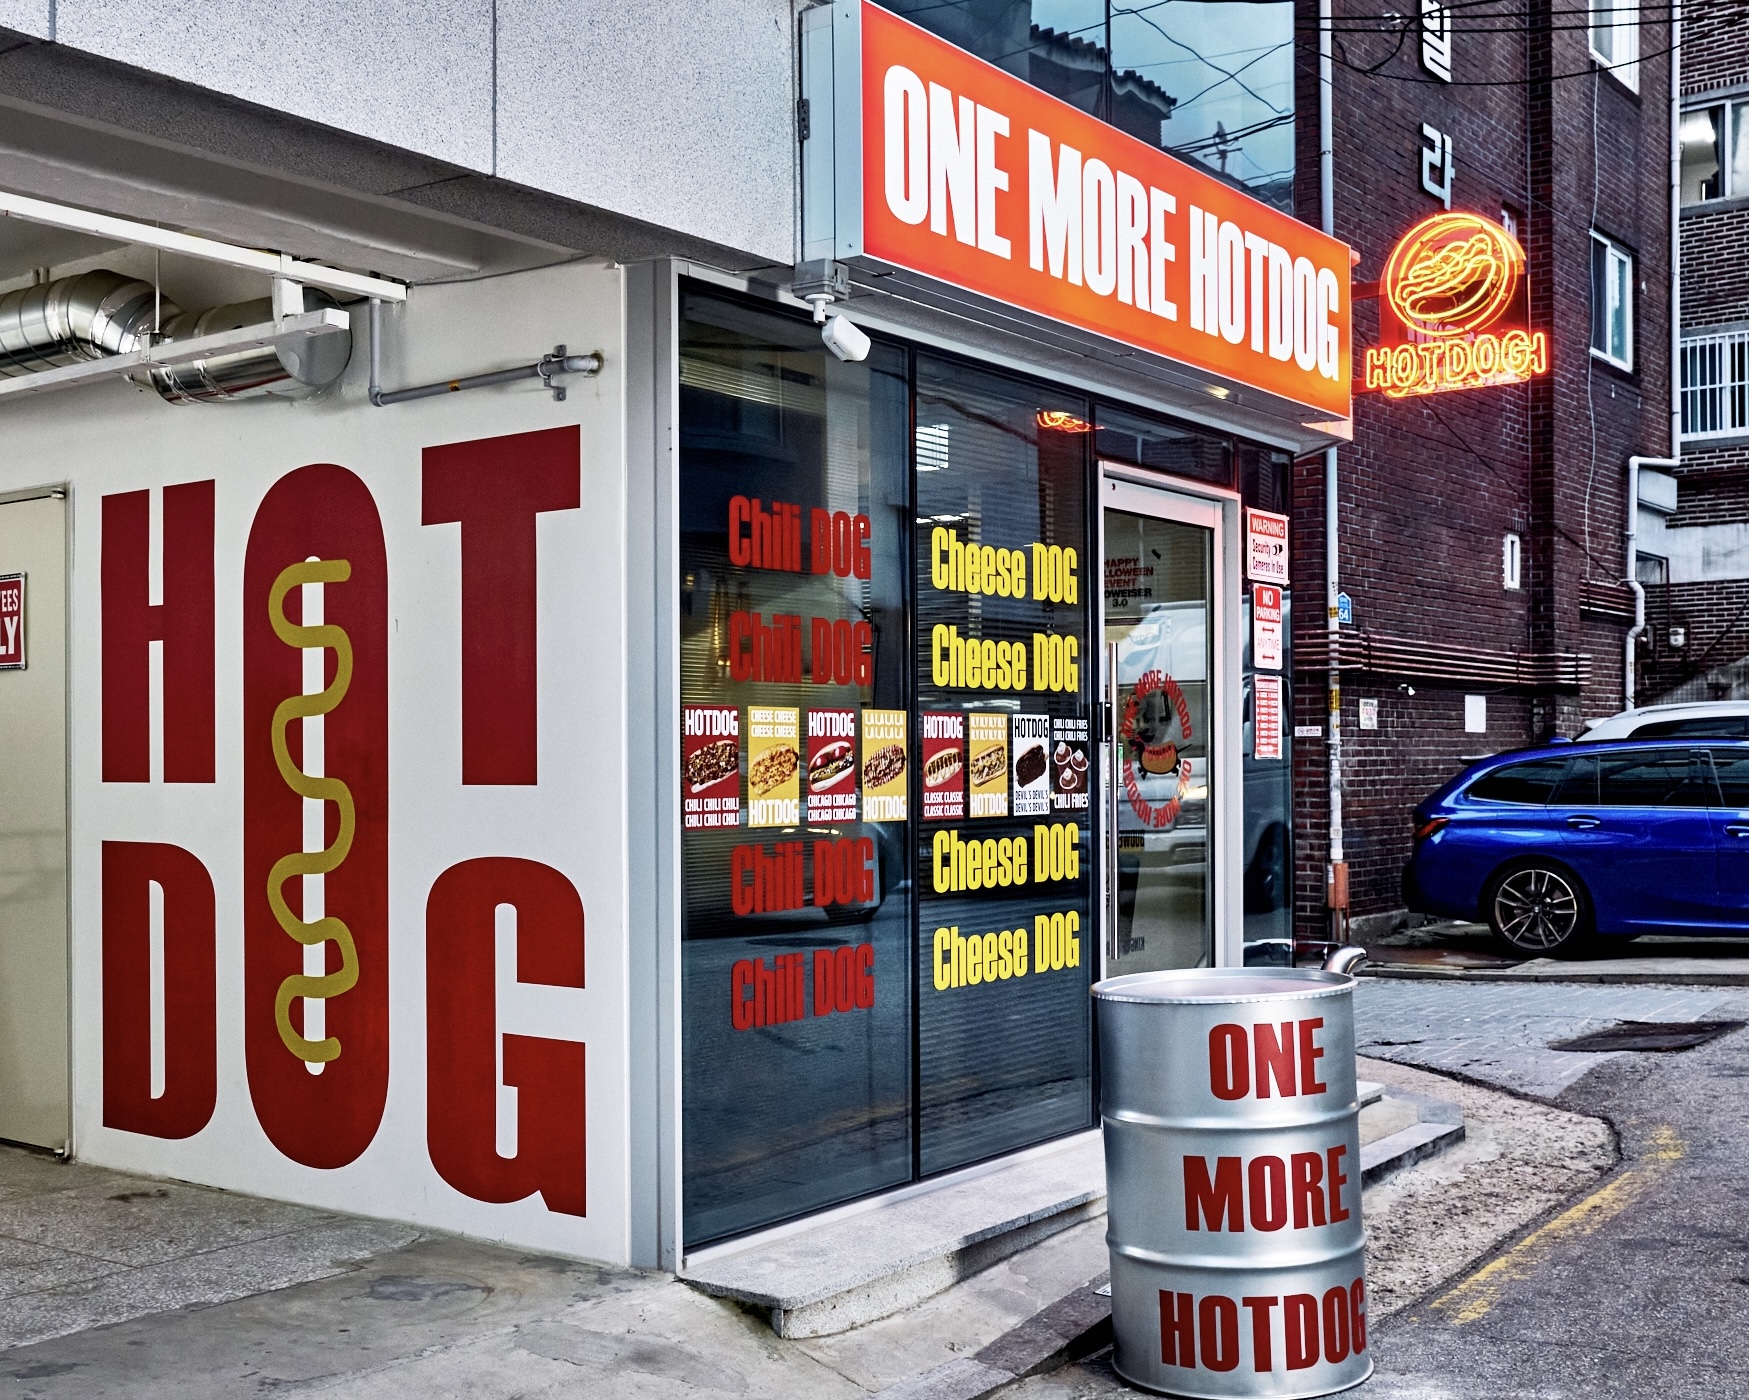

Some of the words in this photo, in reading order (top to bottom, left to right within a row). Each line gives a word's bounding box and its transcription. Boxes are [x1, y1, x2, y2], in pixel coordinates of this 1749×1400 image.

[884, 65, 1011, 260] ONE
[1028, 128, 1177, 322] MORE
[1190, 204, 1339, 382] HOTDOG
[1366, 330, 1532, 389] HOTDOG
[729, 495, 800, 571] Chili
[810, 508, 871, 580] DOG
[1252, 517, 1283, 537] WARNING
[1253, 539, 1270, 557] Security
[931, 527, 1026, 598] Cheese
[1033, 542, 1078, 604] DOG
[0, 589, 18, 612] EES
[1112, 599, 1128, 607] 3.0
[1262, 590, 1273, 606] NO
[101, 424, 581, 815] HOT
[1257, 606, 1280, 621] PARKING
[729, 610, 800, 684] Chili
[811, 617, 872, 686] DOG
[931, 624, 1026, 690] Cheese
[1033, 633, 1078, 693] DOG
[685, 709, 738, 736] HOTDOG
[751, 710, 773, 722] CHEESE
[775, 711, 796, 723] CHEESE
[808, 712, 854, 737] HOTDOG
[924, 716, 963, 739] HOTDOG
[1014, 718, 1048, 738] HOTDOG
[751, 725, 773, 737] CHEESE
[775, 726, 796, 738] CHEESE
[685, 799, 702, 812] CHILI
[704, 798, 721, 811] CHILI
[723, 797, 739, 810] CHILI
[808, 795, 832, 807] CHICAGO
[833, 794, 856, 806] CHICAGO
[863, 795, 907, 819] HOTDOG
[924, 792, 943, 803] CLASSIC
[944, 791, 963, 802] CLASSIC
[970, 793, 1008, 815] HOTDOG
[1054, 793, 1070, 808] CHILI
[1072, 793, 1088, 808] FRIES
[685, 814, 702, 827] CHILI
[704, 813, 721, 827] CHILI
[723, 812, 739, 826] CHILI
[750, 799, 799, 825] HOTDOG
[808, 809, 832, 821] CHICAGO
[833, 808, 856, 820] CHICAGO
[924, 805, 943, 816] CLASSIC
[944, 805, 963, 816] CLASSIC
[933, 830, 1027, 894] Cheese
[1034, 822, 1079, 883] DOG
[732, 842, 803, 916] Chili
[813, 837, 874, 906] DOG
[933, 926, 1028, 991] Cheese
[1034, 910, 1079, 974] DOG
[731, 952, 803, 1031] Chili
[813, 943, 874, 1017] DOG
[102, 815, 587, 1218] DOG
[1209, 1016, 1326, 1100] ONE
[1183, 1144, 1349, 1232] MORE
[1159, 1277, 1366, 1373] HOTDOG
